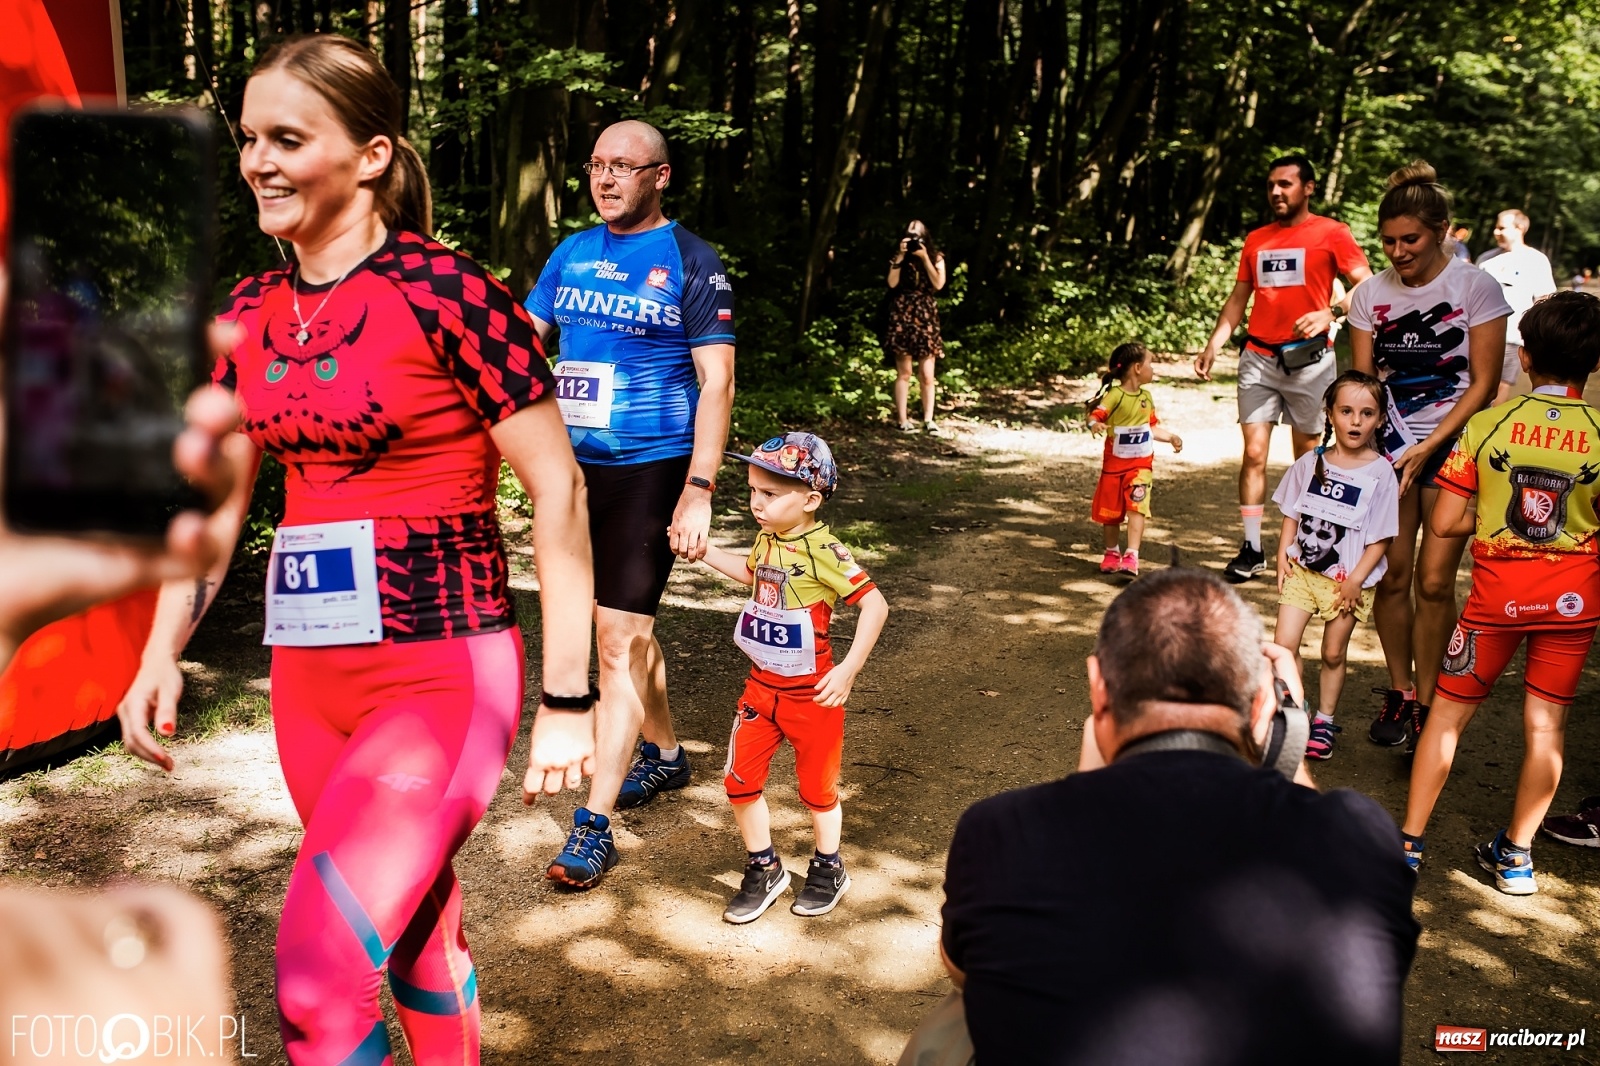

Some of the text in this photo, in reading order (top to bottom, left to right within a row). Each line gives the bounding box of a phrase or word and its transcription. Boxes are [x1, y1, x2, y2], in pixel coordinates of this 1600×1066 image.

[1270, 260, 1288, 271] 76
[554, 286, 681, 327] UNNERS
[611, 322, 647, 336] TEAM
[556, 378, 590, 399] 112
[1129, 433, 1144, 444] 77
[1509, 422, 1591, 454] RAFAŁ
[1320, 480, 1345, 500] 66
[1527, 526, 1547, 538] OCR
[283, 553, 319, 590] 81
[1519, 603, 1549, 612] MebRaj
[749, 618, 789, 645] 113
[377, 773, 431, 792] 4F
